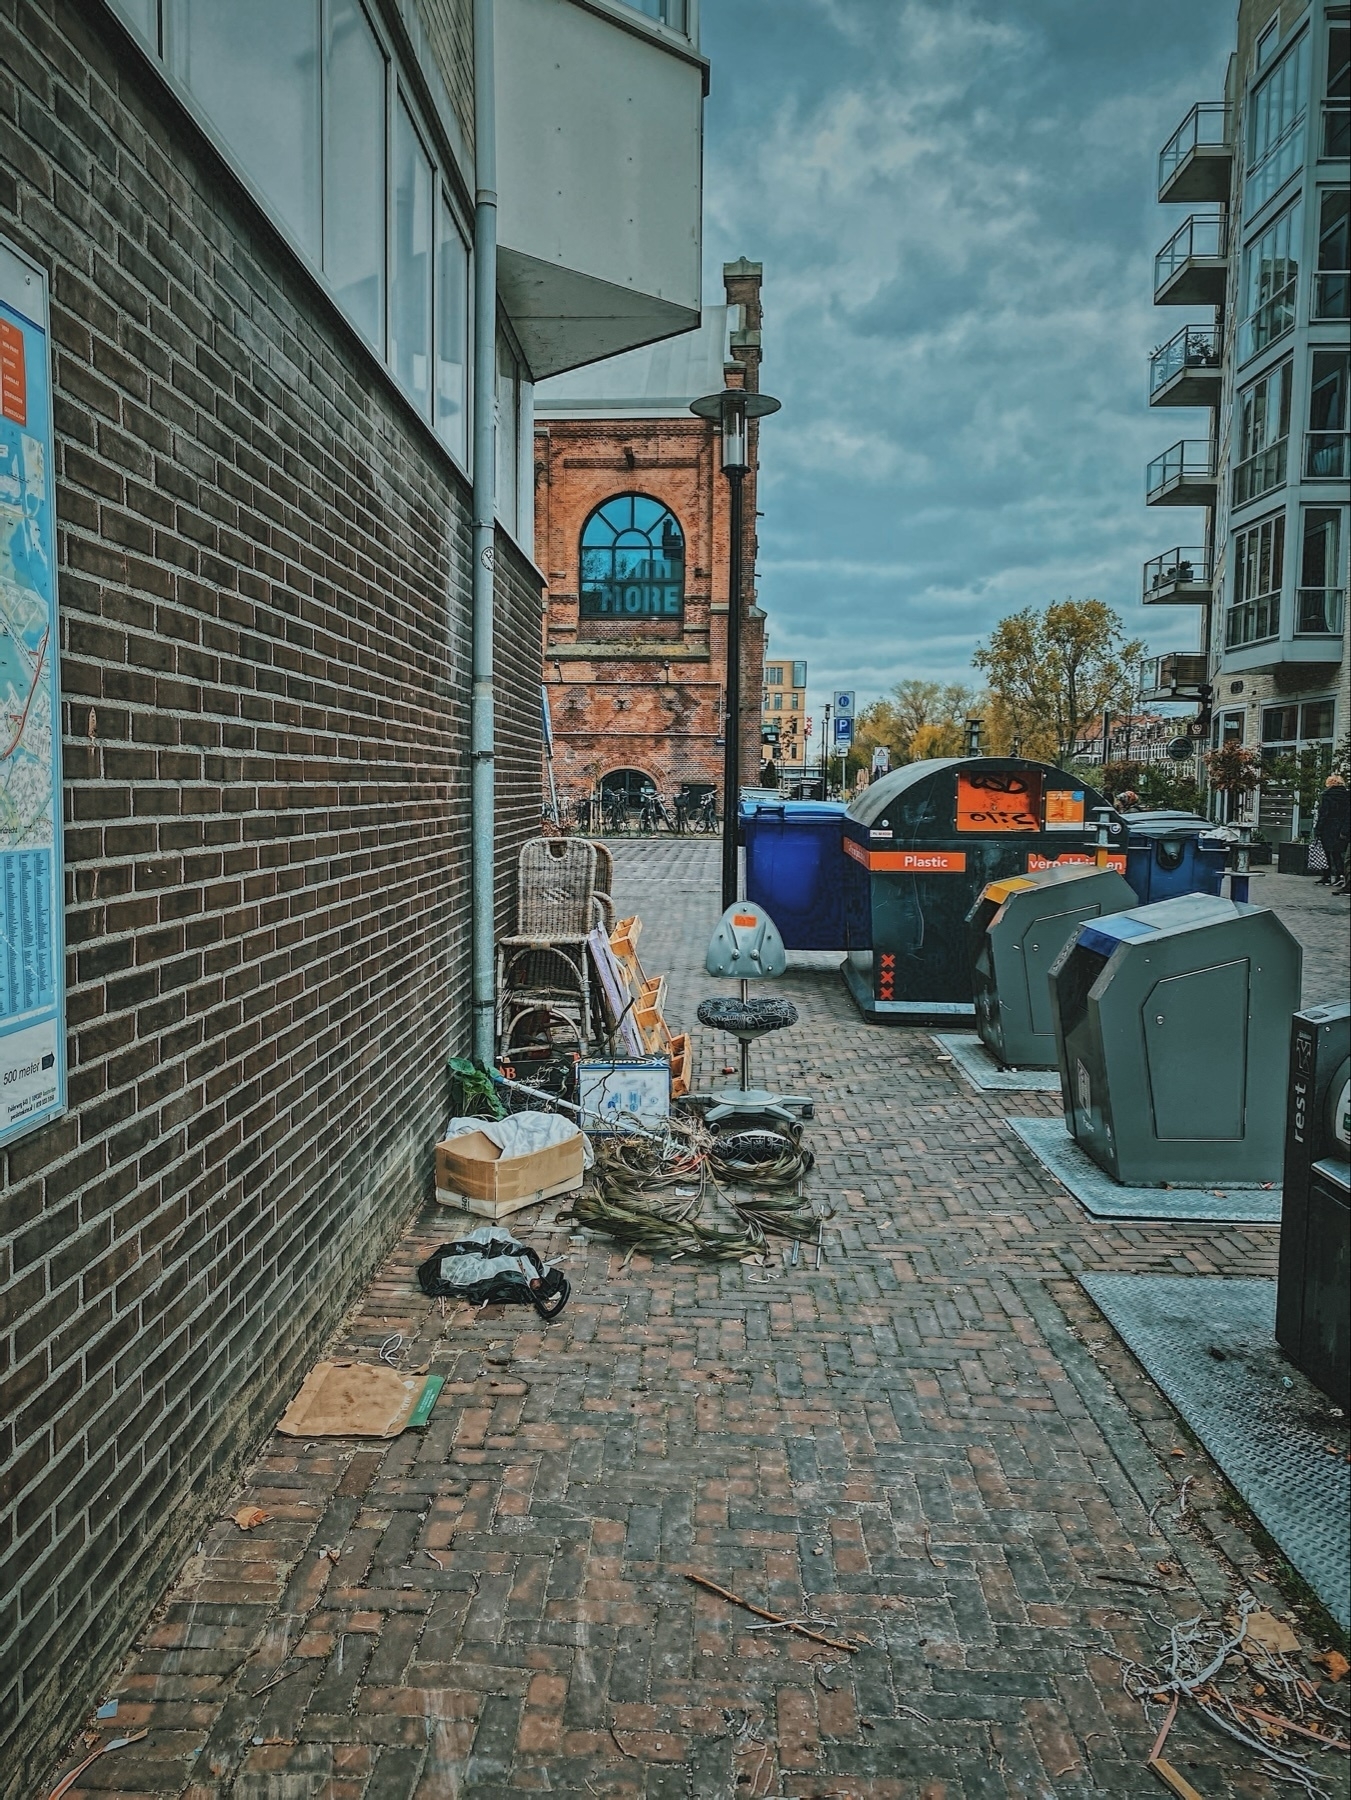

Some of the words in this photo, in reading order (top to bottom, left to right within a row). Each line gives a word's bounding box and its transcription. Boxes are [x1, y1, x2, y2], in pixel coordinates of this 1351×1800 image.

[601, 585, 679, 613] MORE
[839, 720, 848, 731] P
[904, 855, 948, 868] Plastic
[3, 1069, 17, 1085] 500
[19, 1062, 40, 1079] meter
[1294, 1082, 1306, 1143] rest
